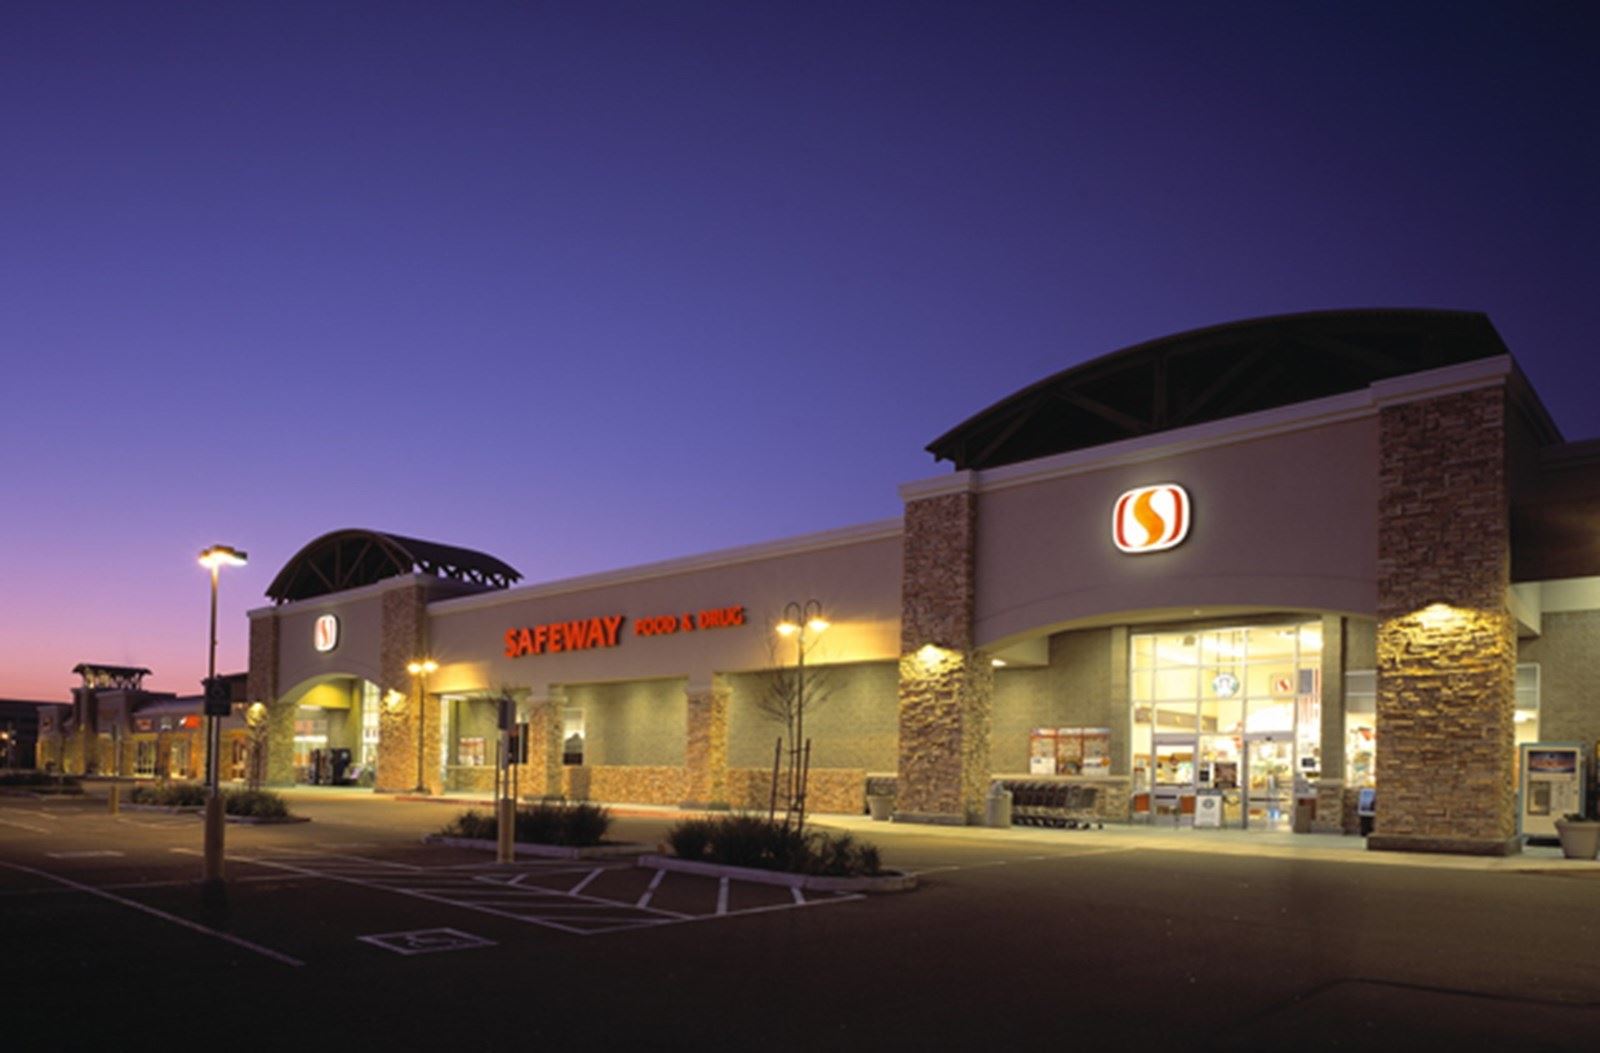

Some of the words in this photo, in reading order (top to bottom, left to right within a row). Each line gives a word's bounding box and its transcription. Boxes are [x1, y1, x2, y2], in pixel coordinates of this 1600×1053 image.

[504, 614, 623, 659] SAFEWAY
[634, 615, 678, 635] FOOD
[681, 613, 695, 631] &
[698, 605, 745, 629] DRUG
